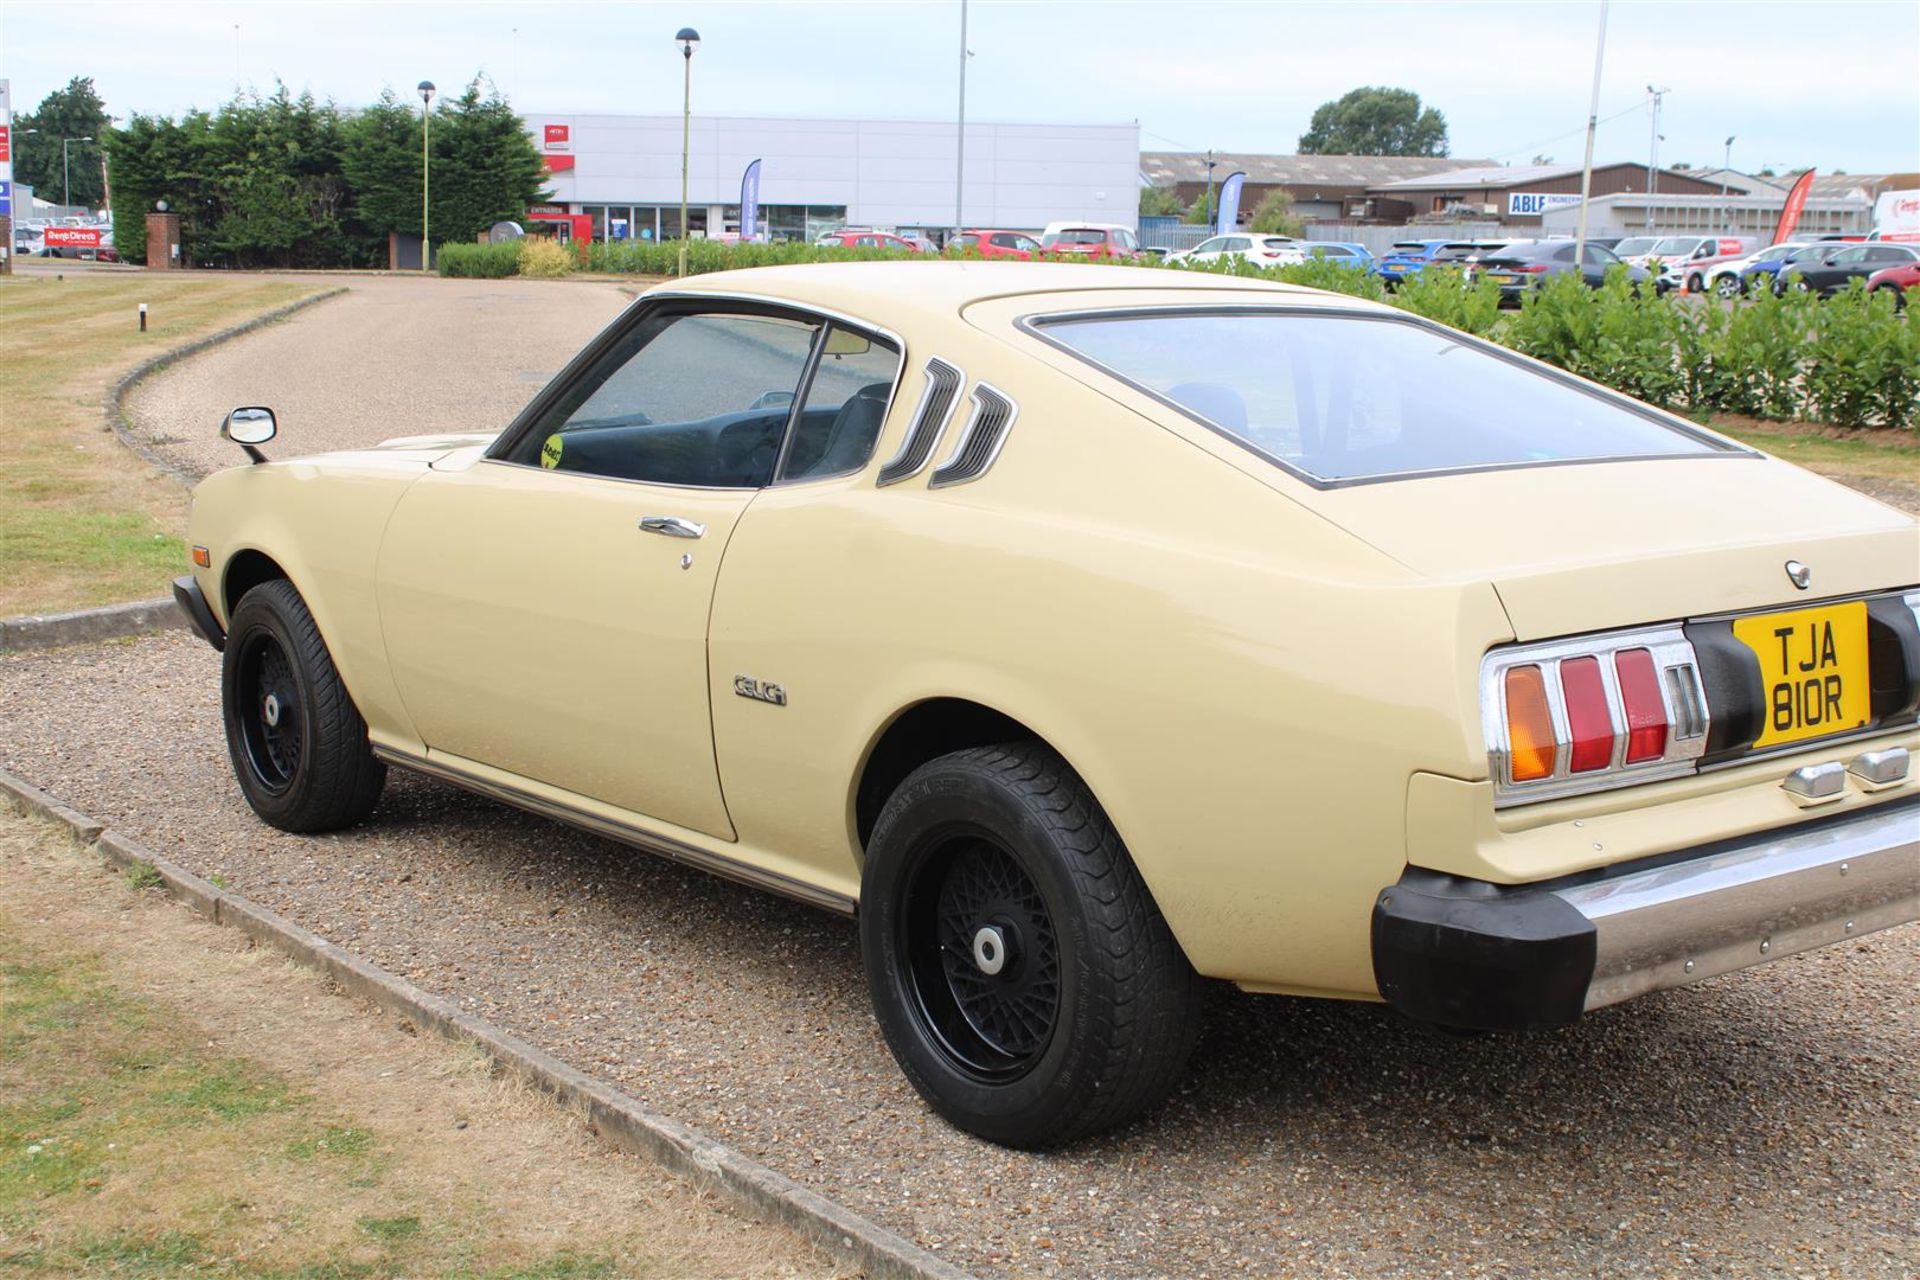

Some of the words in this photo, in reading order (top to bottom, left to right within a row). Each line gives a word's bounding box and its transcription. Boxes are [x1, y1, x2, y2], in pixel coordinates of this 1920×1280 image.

[1774, 621, 1838, 676] TJA
[735, 675, 787, 707] CELICA
[1773, 674, 1843, 732] 810R
